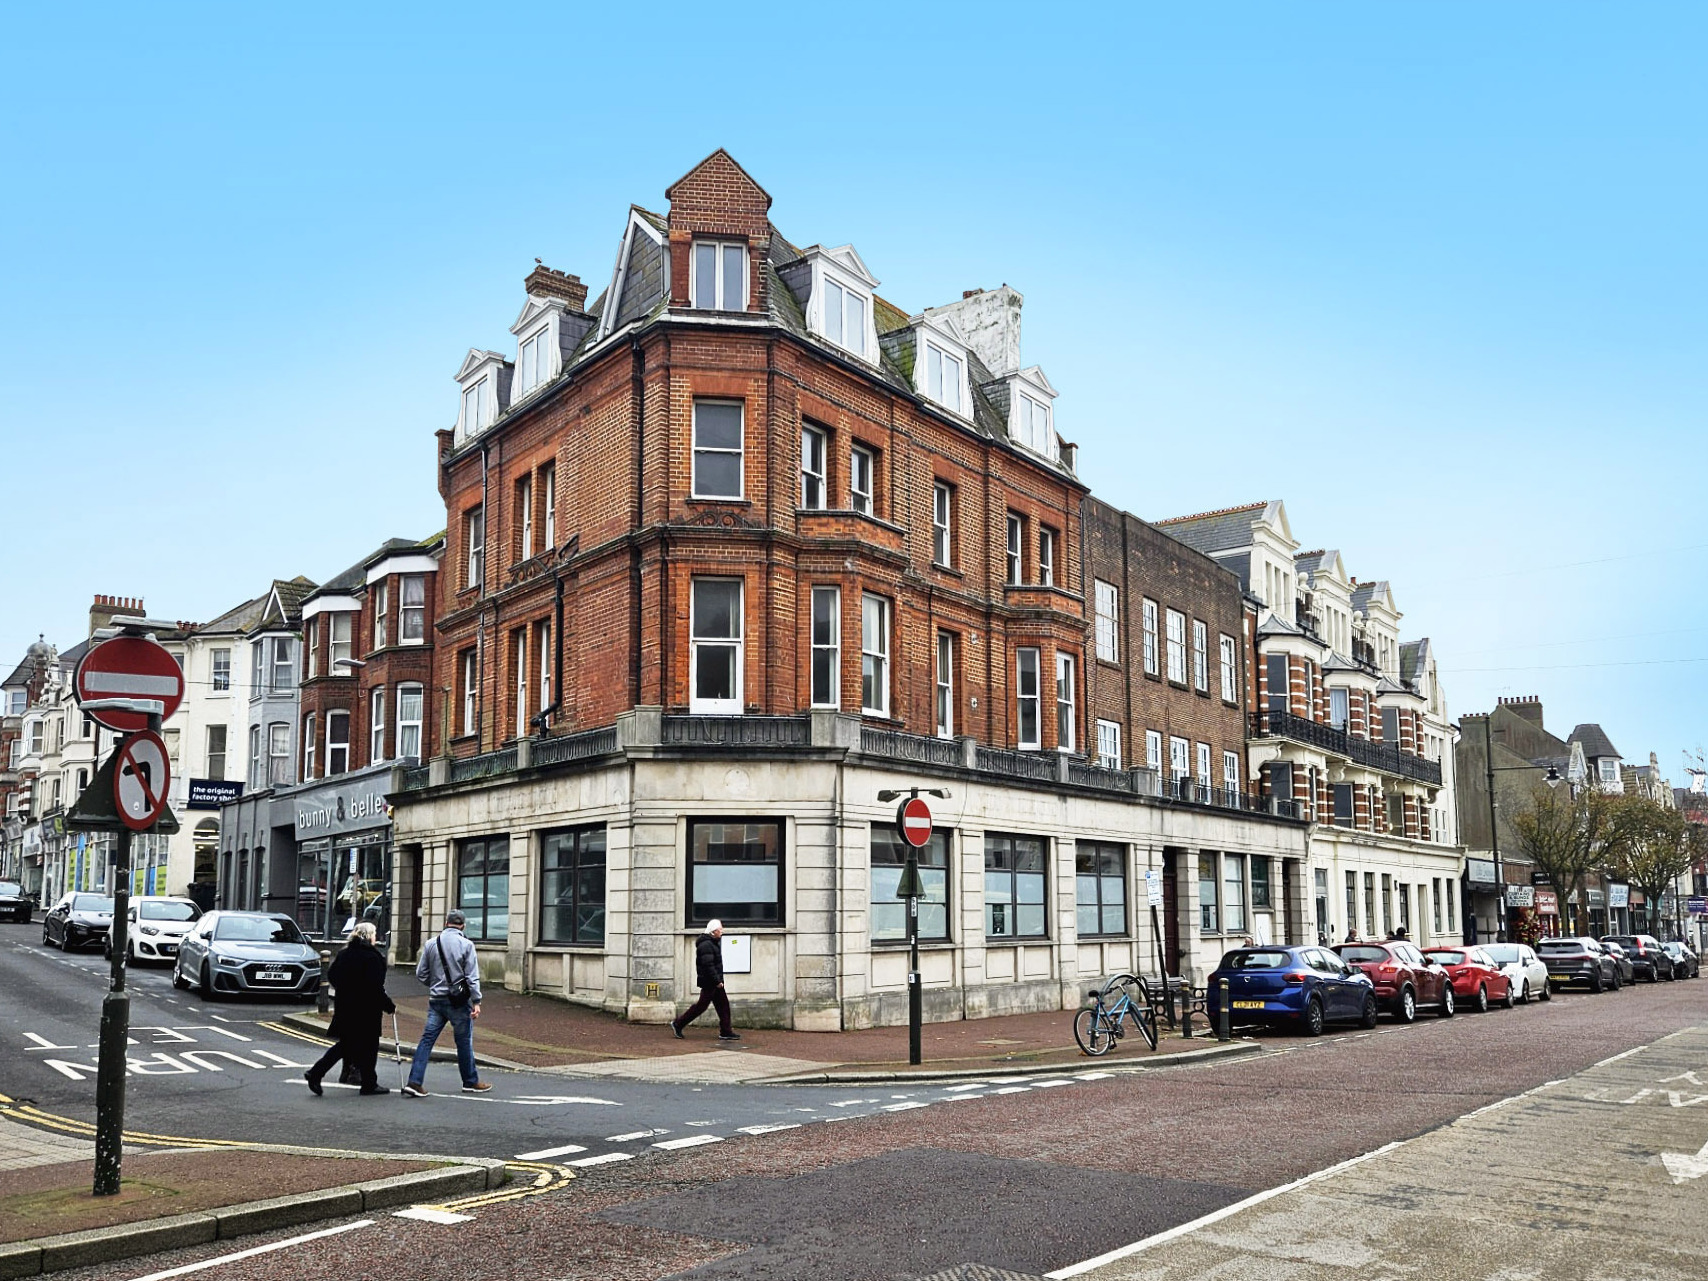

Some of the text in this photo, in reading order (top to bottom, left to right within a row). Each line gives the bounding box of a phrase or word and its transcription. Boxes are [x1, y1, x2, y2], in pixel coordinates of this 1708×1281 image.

[207, 787, 235, 795] original
[192, 793, 218, 802] factory
[299, 792, 382, 829] bunny & belle
[648, 985, 658, 997] H
